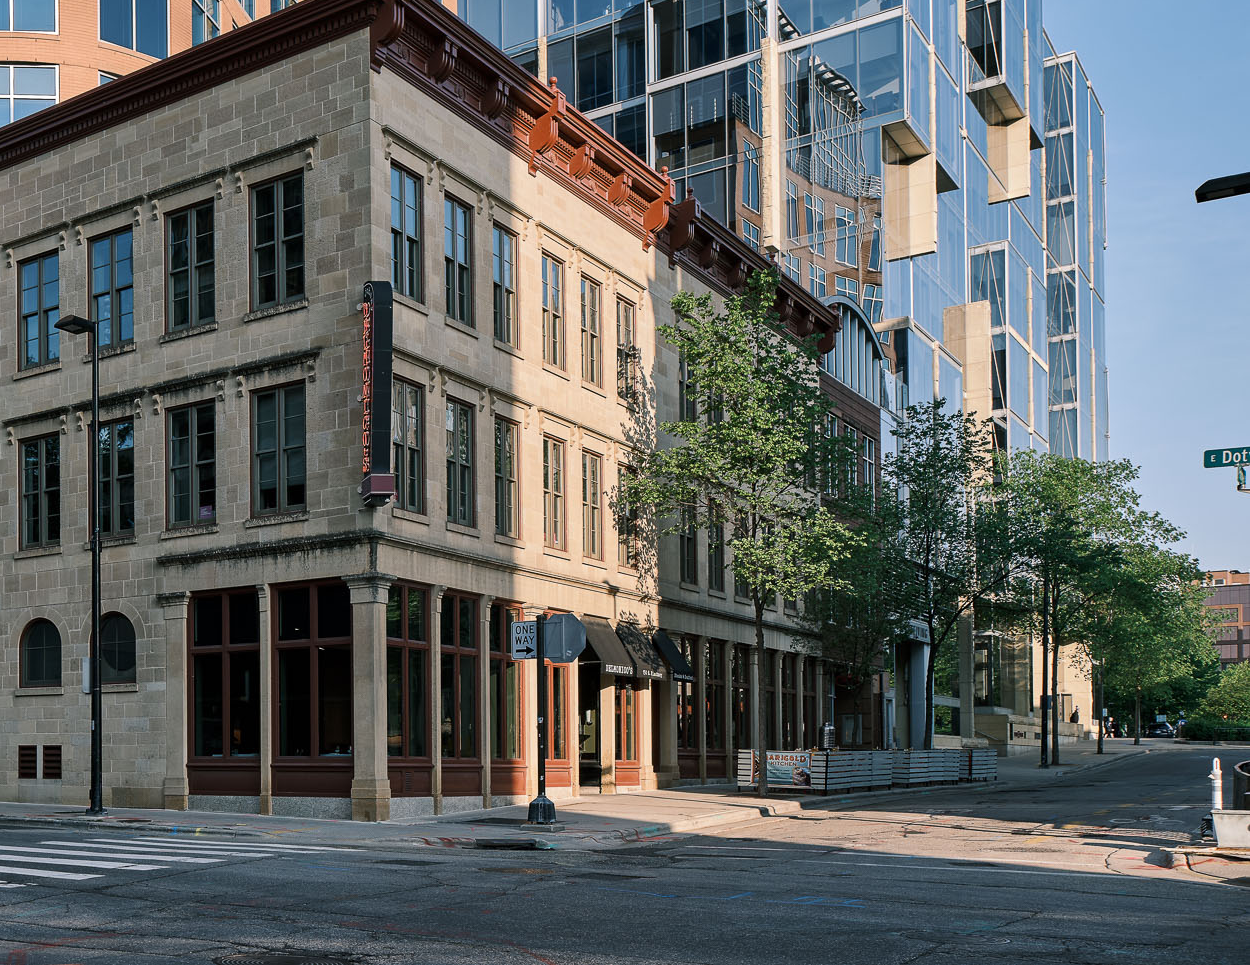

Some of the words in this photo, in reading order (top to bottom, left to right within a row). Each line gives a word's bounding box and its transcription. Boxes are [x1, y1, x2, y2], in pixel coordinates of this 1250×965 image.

[1210, 454, 1217, 463] E
[1222, 449, 1250, 464] Dot
[515, 625, 535, 635] ONE
[515, 636, 535, 645] WAY
[766, 754, 807, 763] ARIGOLD
